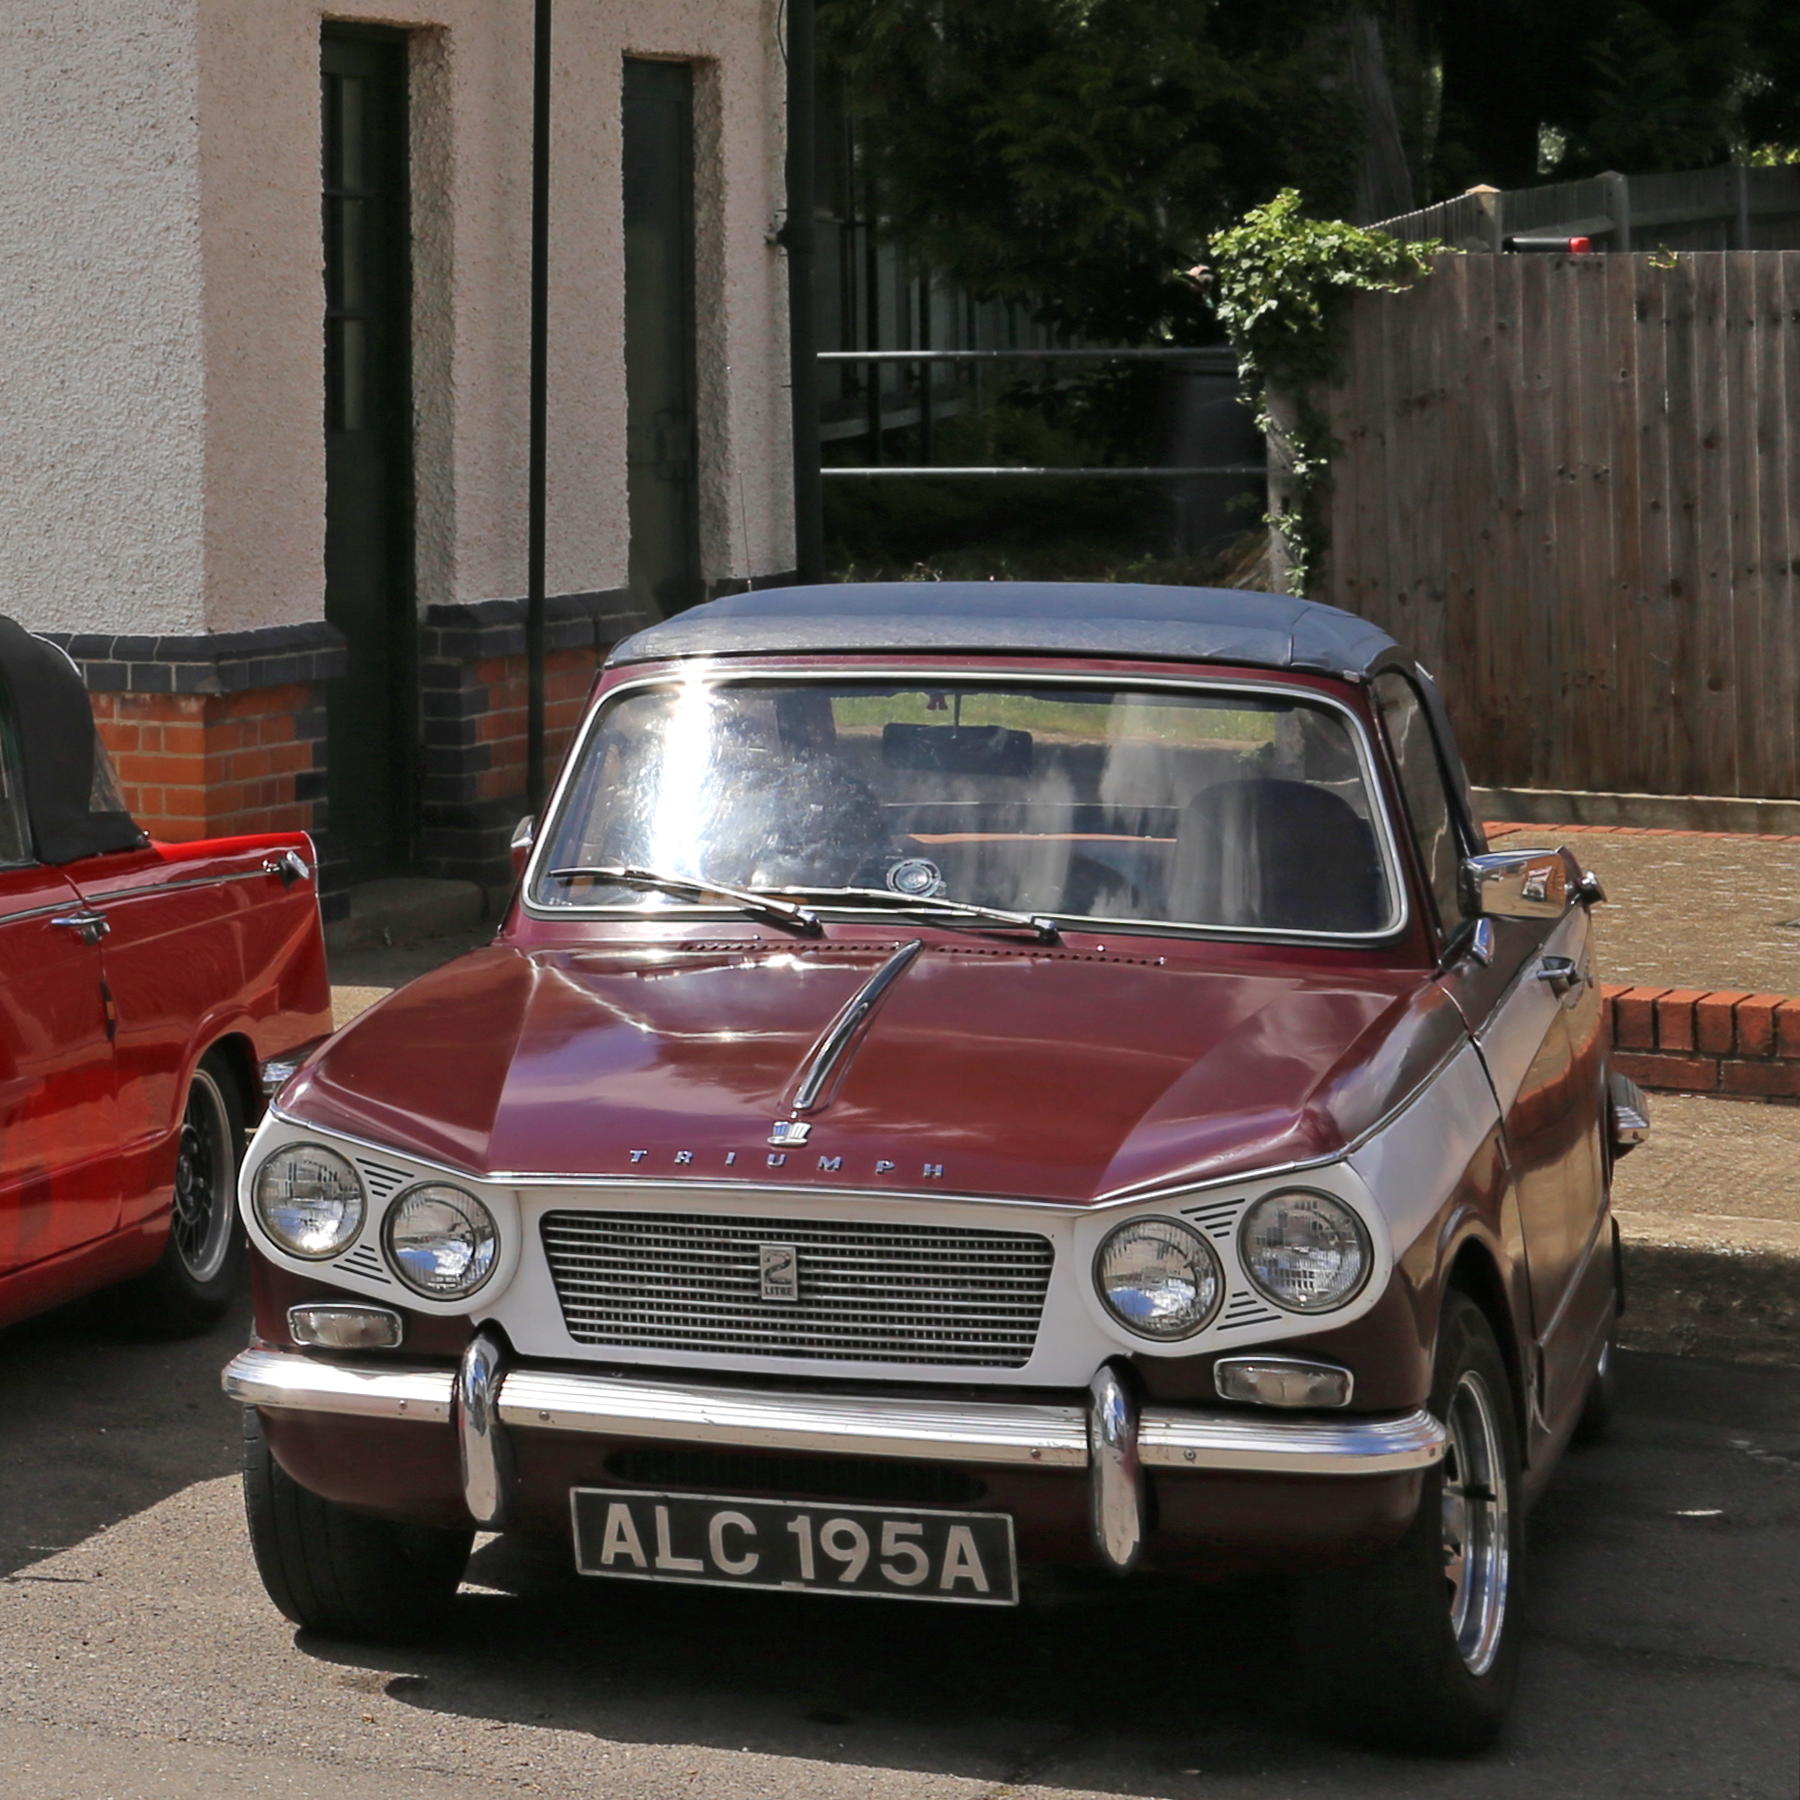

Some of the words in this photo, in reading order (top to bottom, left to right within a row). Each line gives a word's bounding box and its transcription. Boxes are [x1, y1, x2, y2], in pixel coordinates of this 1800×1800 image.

[629, 1149, 945, 1178] TRIUMPH
[764, 1249, 793, 1286] 2
[764, 1286, 793, 1297] LITRE
[600, 1502, 760, 1576] ALC
[787, 1514, 991, 1593] 195A
